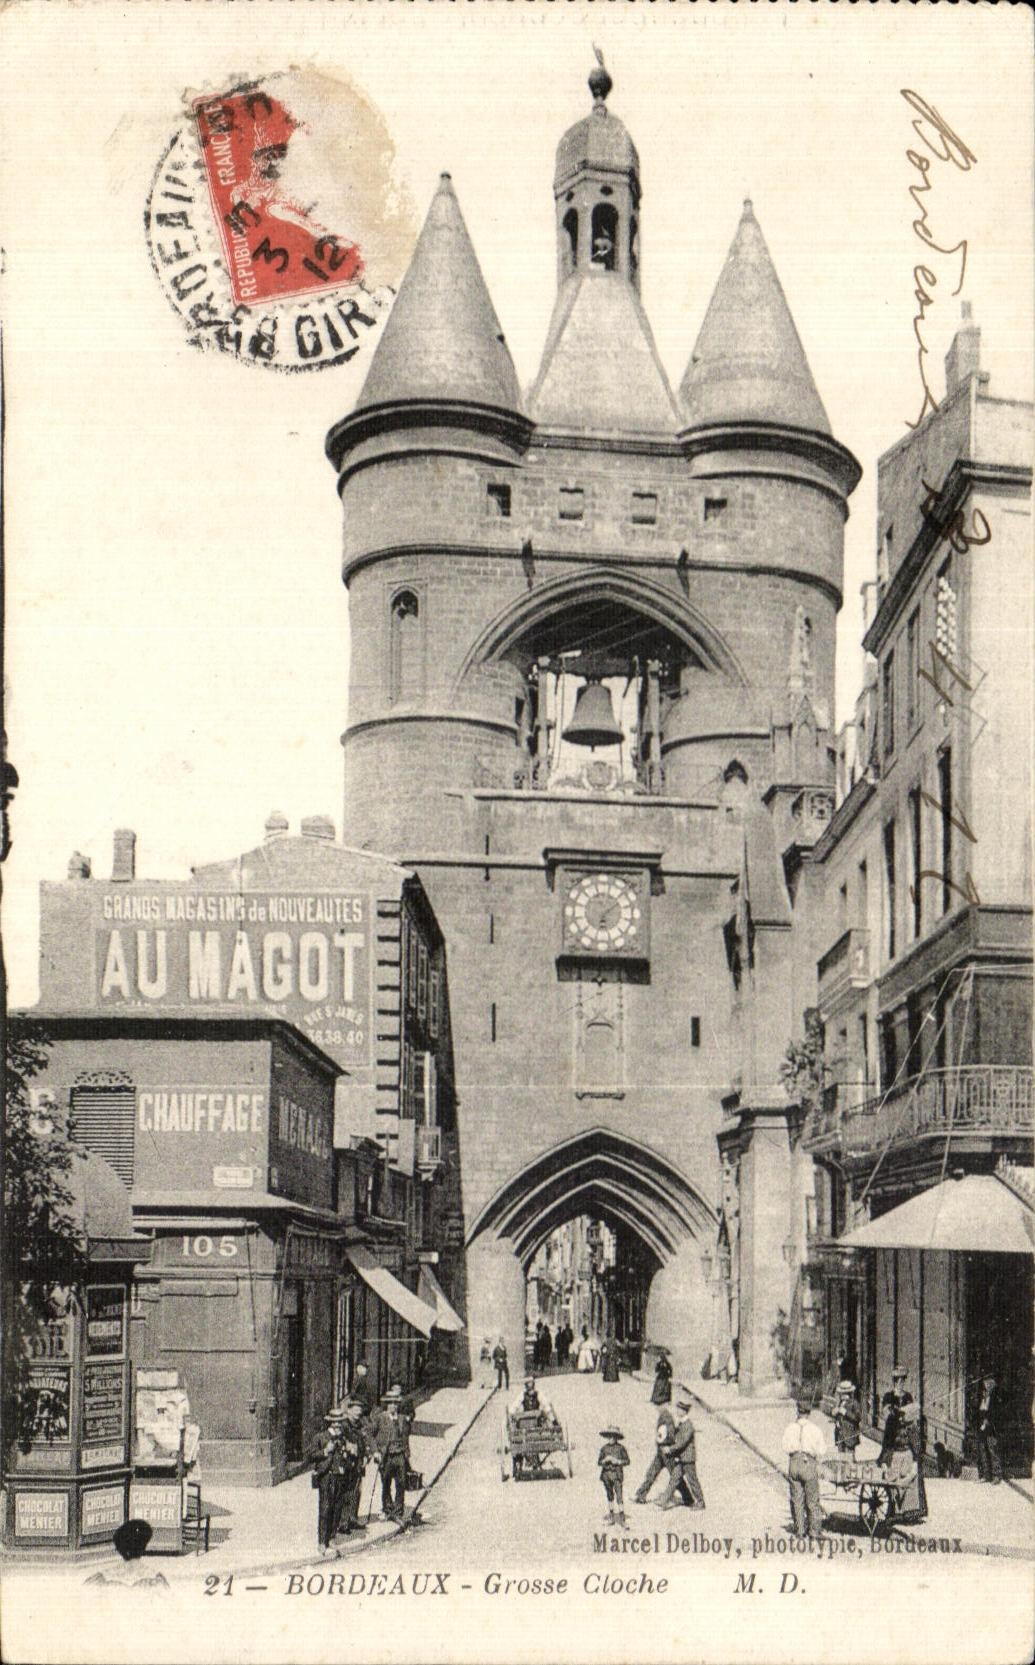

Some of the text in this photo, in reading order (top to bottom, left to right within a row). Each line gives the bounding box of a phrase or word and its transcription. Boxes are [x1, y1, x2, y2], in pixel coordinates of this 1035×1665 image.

[103, 895, 160, 920] GRANDS
[166, 896, 245, 921] MAGASINS
[248, 899, 266, 921] de
[102, 929, 366, 1002] AU MAGOT
[138, 1093, 264, 1132] CHAUFFAGE
[181, 1235, 238, 1257] 105
[18, 1500, 65, 1514] CHOCOLAT
[134, 1507, 176, 1521] MENIER
[20, 1516, 63, 1530] MENIER
[86, 1511, 120, 1527] MENIER
